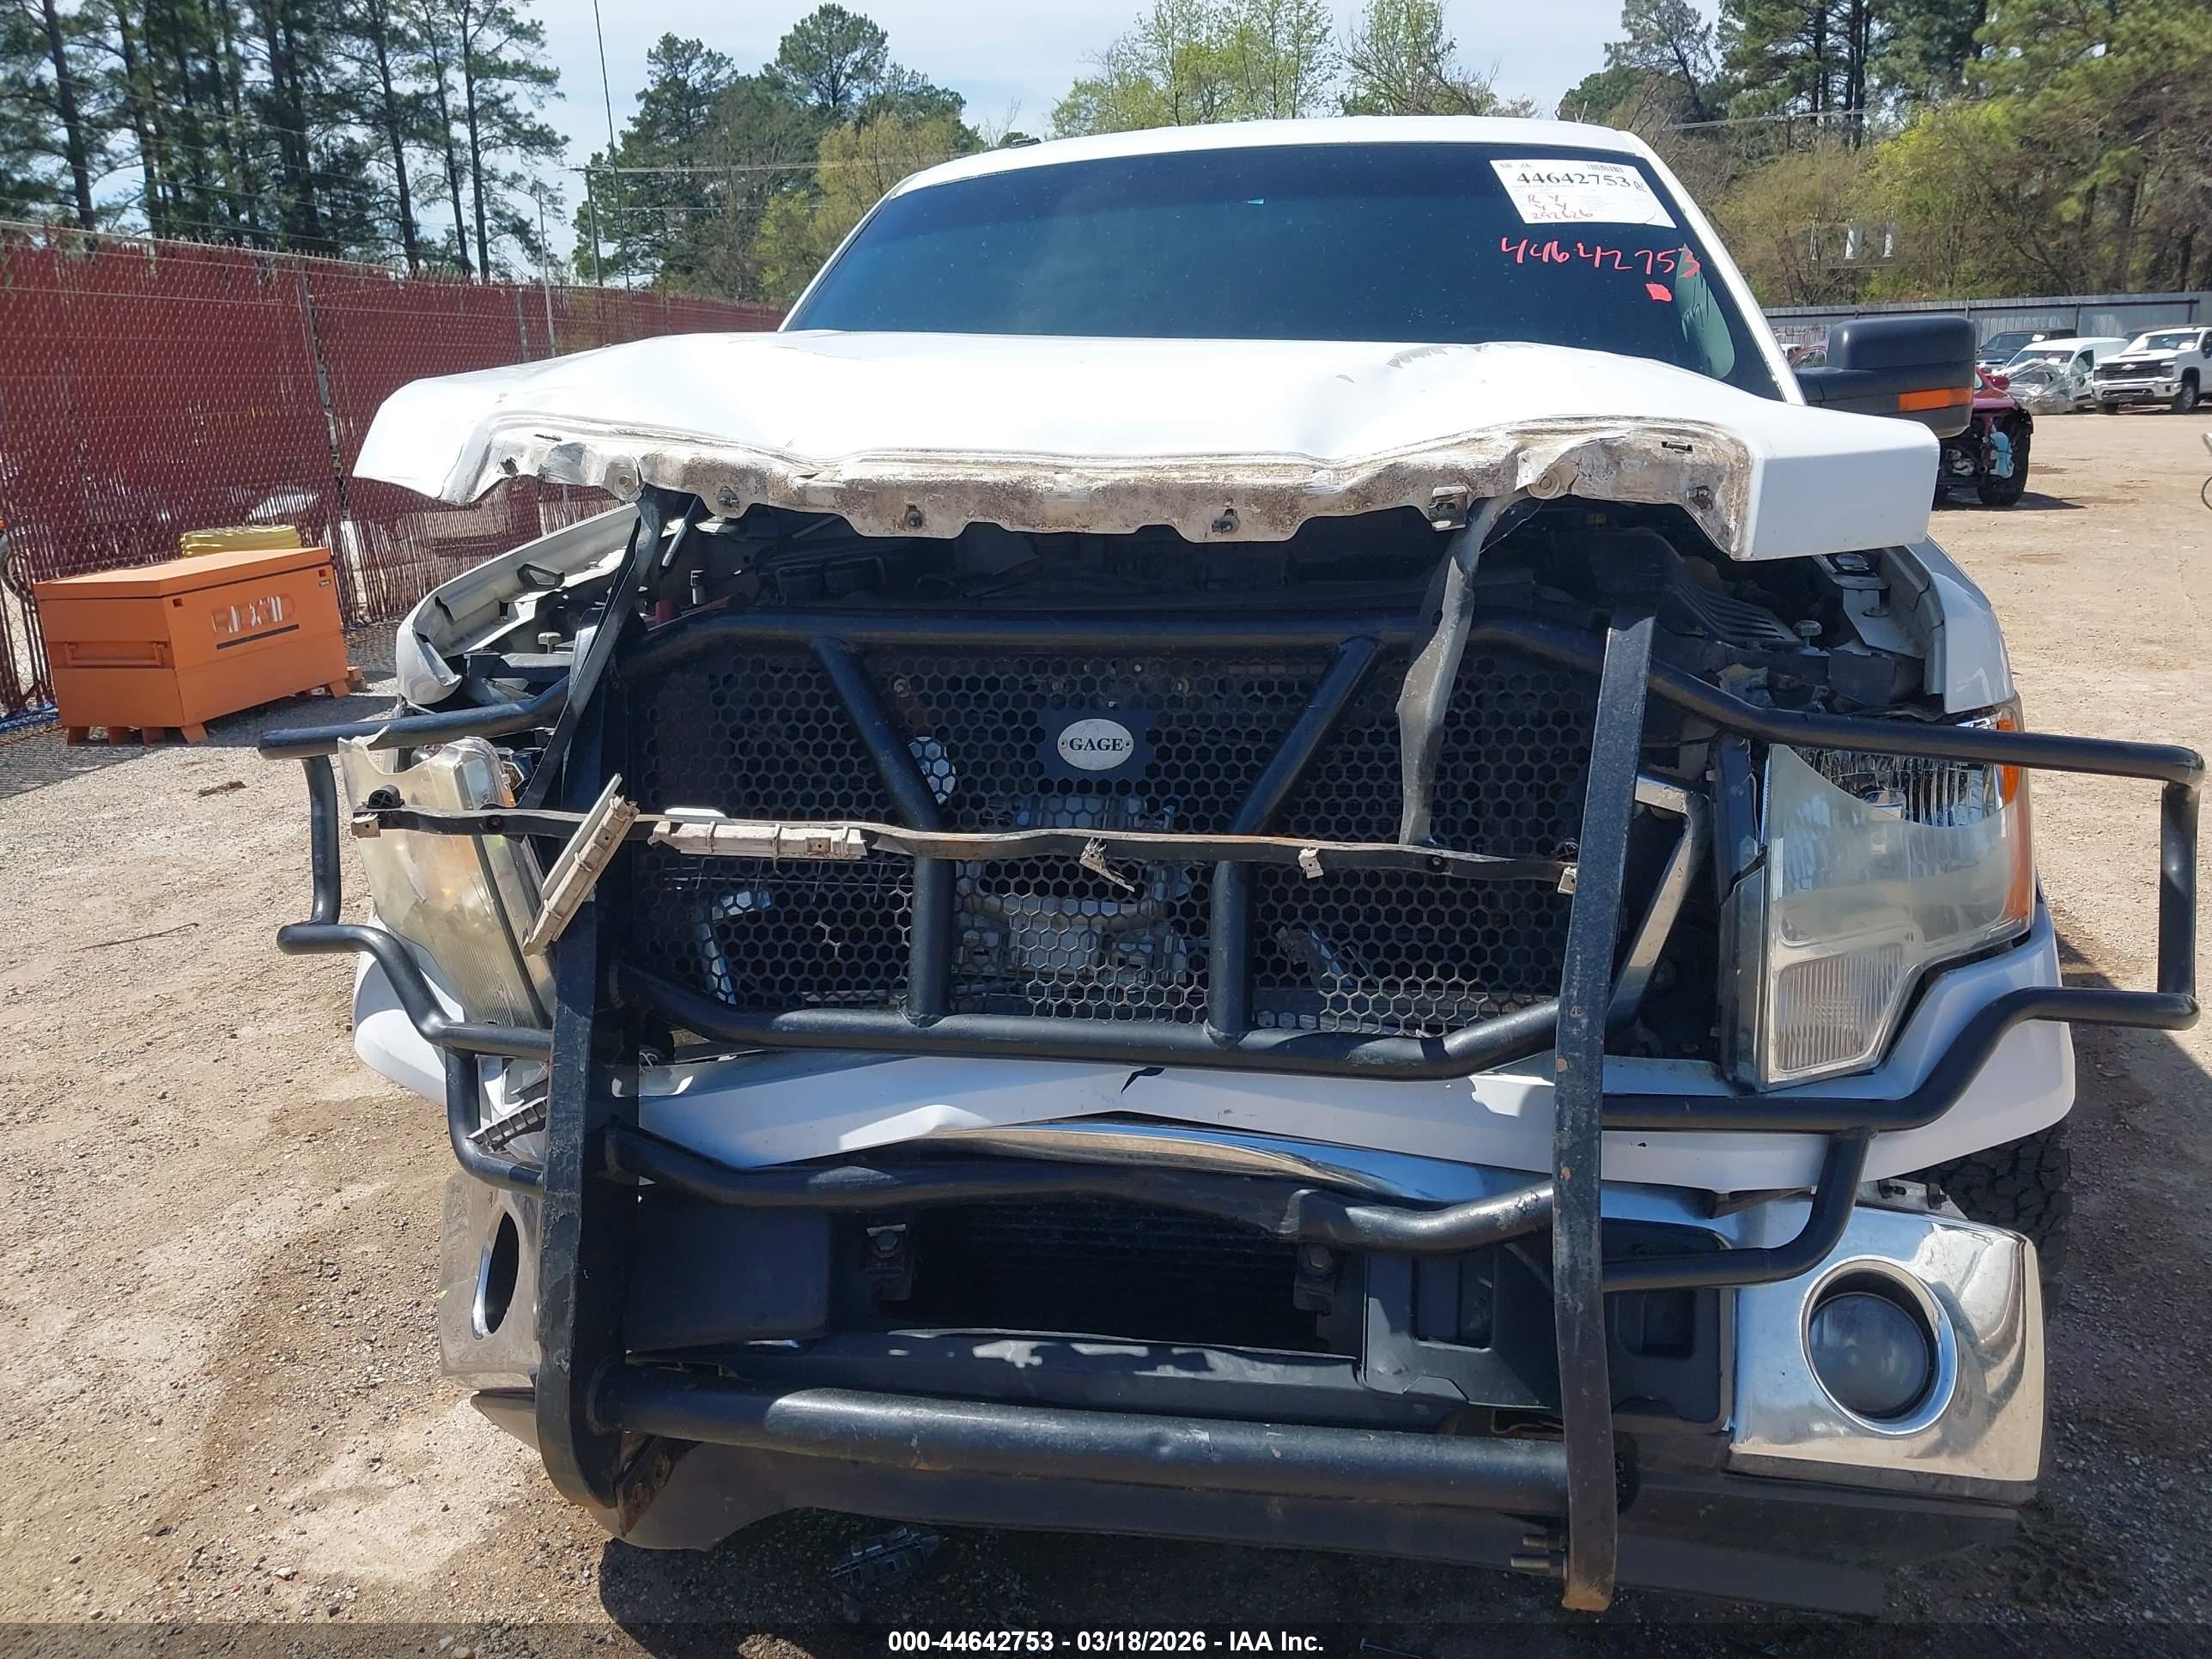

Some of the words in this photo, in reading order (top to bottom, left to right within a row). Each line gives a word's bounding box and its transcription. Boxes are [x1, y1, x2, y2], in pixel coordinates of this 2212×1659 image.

[1517, 173, 1631, 187] 44642753
[1501, 236, 1701, 278] 44642753
[1069, 738, 1123, 751] GAGE
